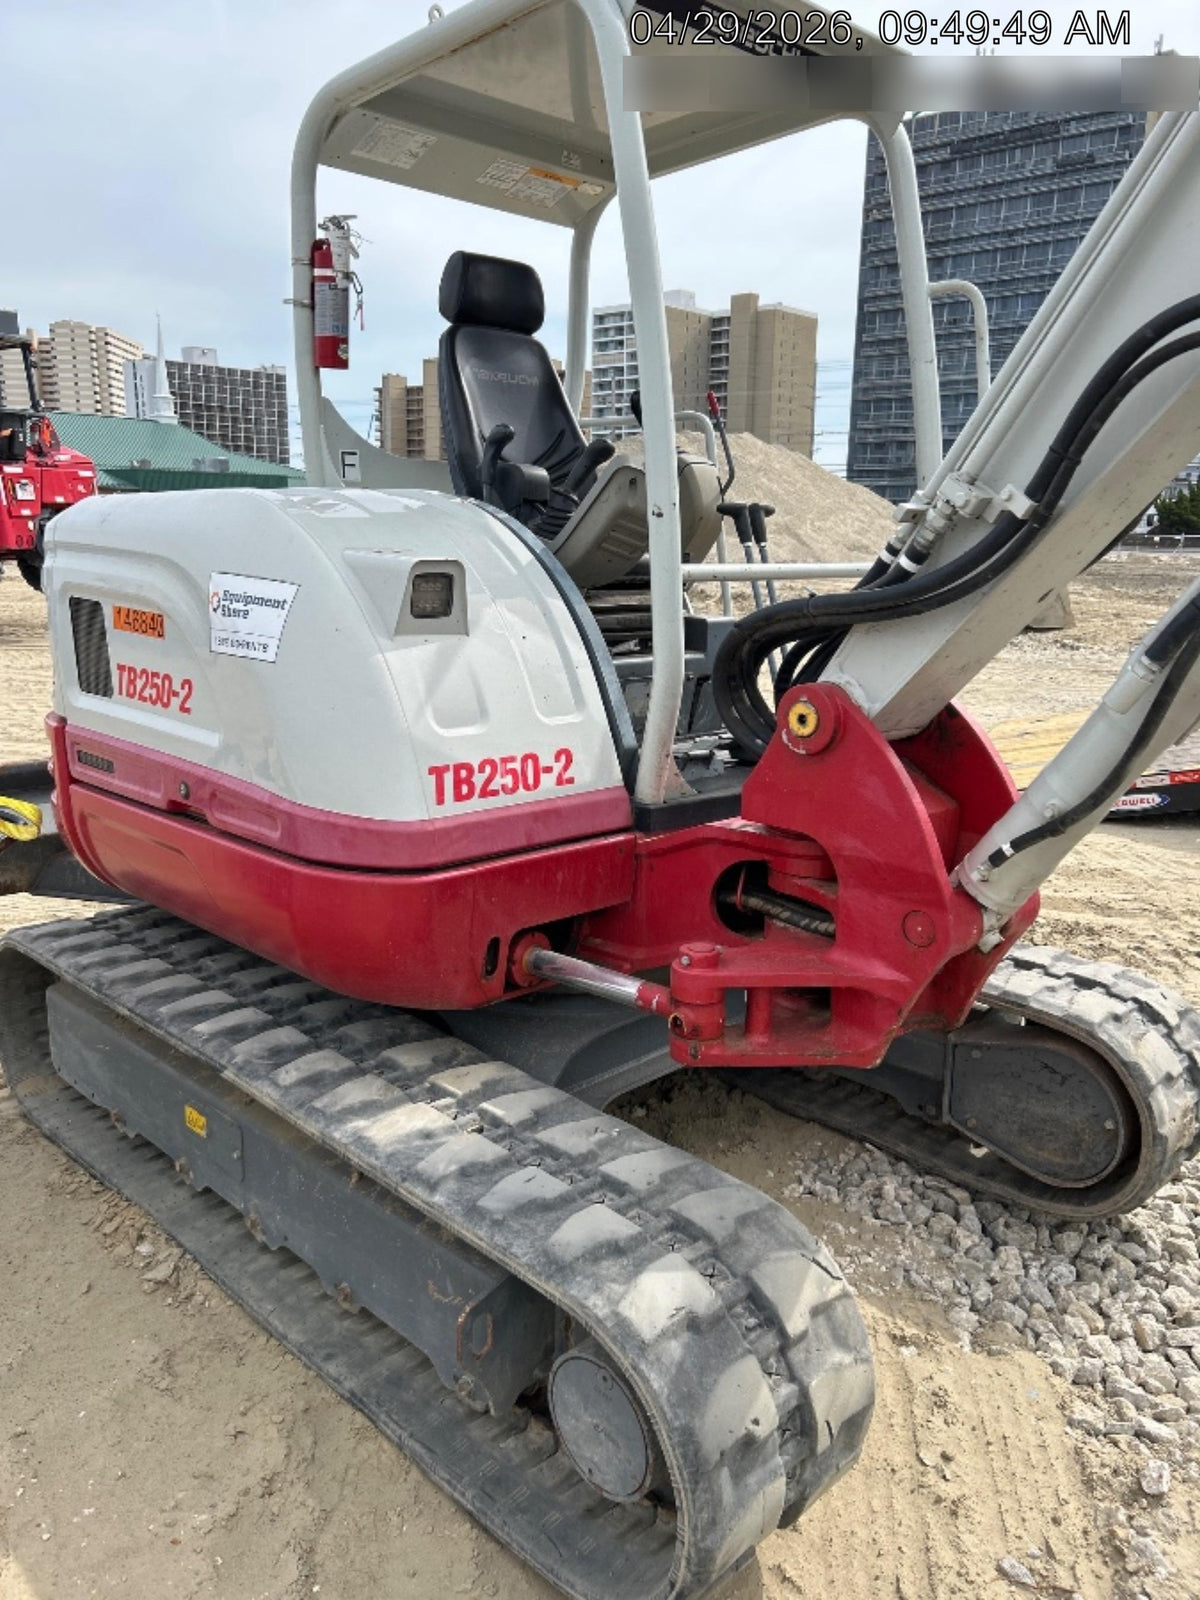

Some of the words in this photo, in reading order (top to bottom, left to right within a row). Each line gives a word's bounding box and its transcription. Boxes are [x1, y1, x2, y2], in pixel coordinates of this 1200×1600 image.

[341, 451, 358, 479] F
[222, 589, 288, 610] Equipment
[116, 663, 193, 714] TB250-2
[428, 748, 575, 806] TB250-2
